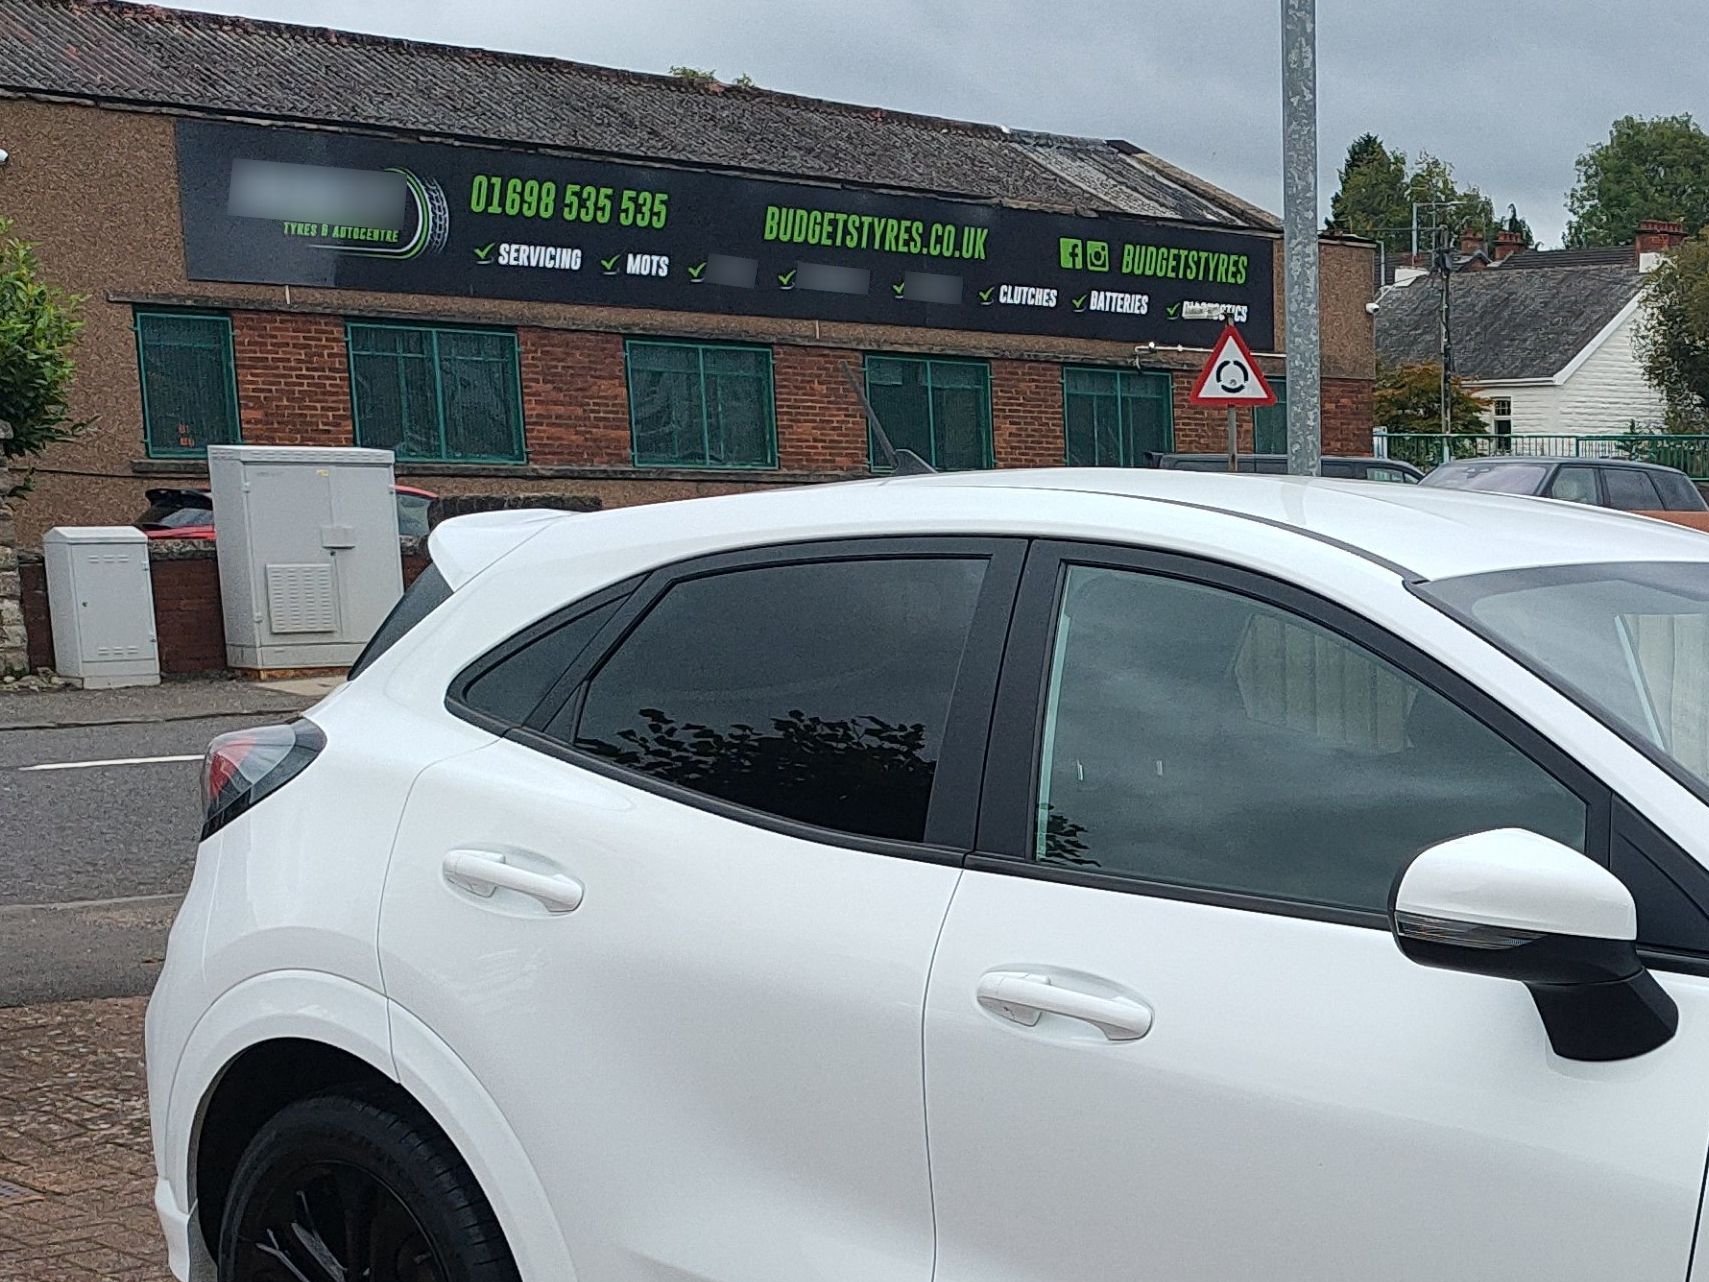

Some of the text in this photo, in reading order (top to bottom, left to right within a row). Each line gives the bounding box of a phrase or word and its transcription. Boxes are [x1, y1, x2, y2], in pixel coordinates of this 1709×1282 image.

[470, 175, 669, 229] 01698 535 535
[283, 222, 318, 237] TYRES
[332, 225, 399, 243] AUTOCENTRE
[763, 205, 989, 260] BUDGETSTYRES.CO.UK
[498, 243, 582, 271] SERVICING
[626, 253, 669, 277] MOTS
[1121, 244, 1248, 285] BUDGETSTYRES
[999, 284, 1058, 308] CLUTCHES
[1089, 290, 1149, 315] BATTERIES
